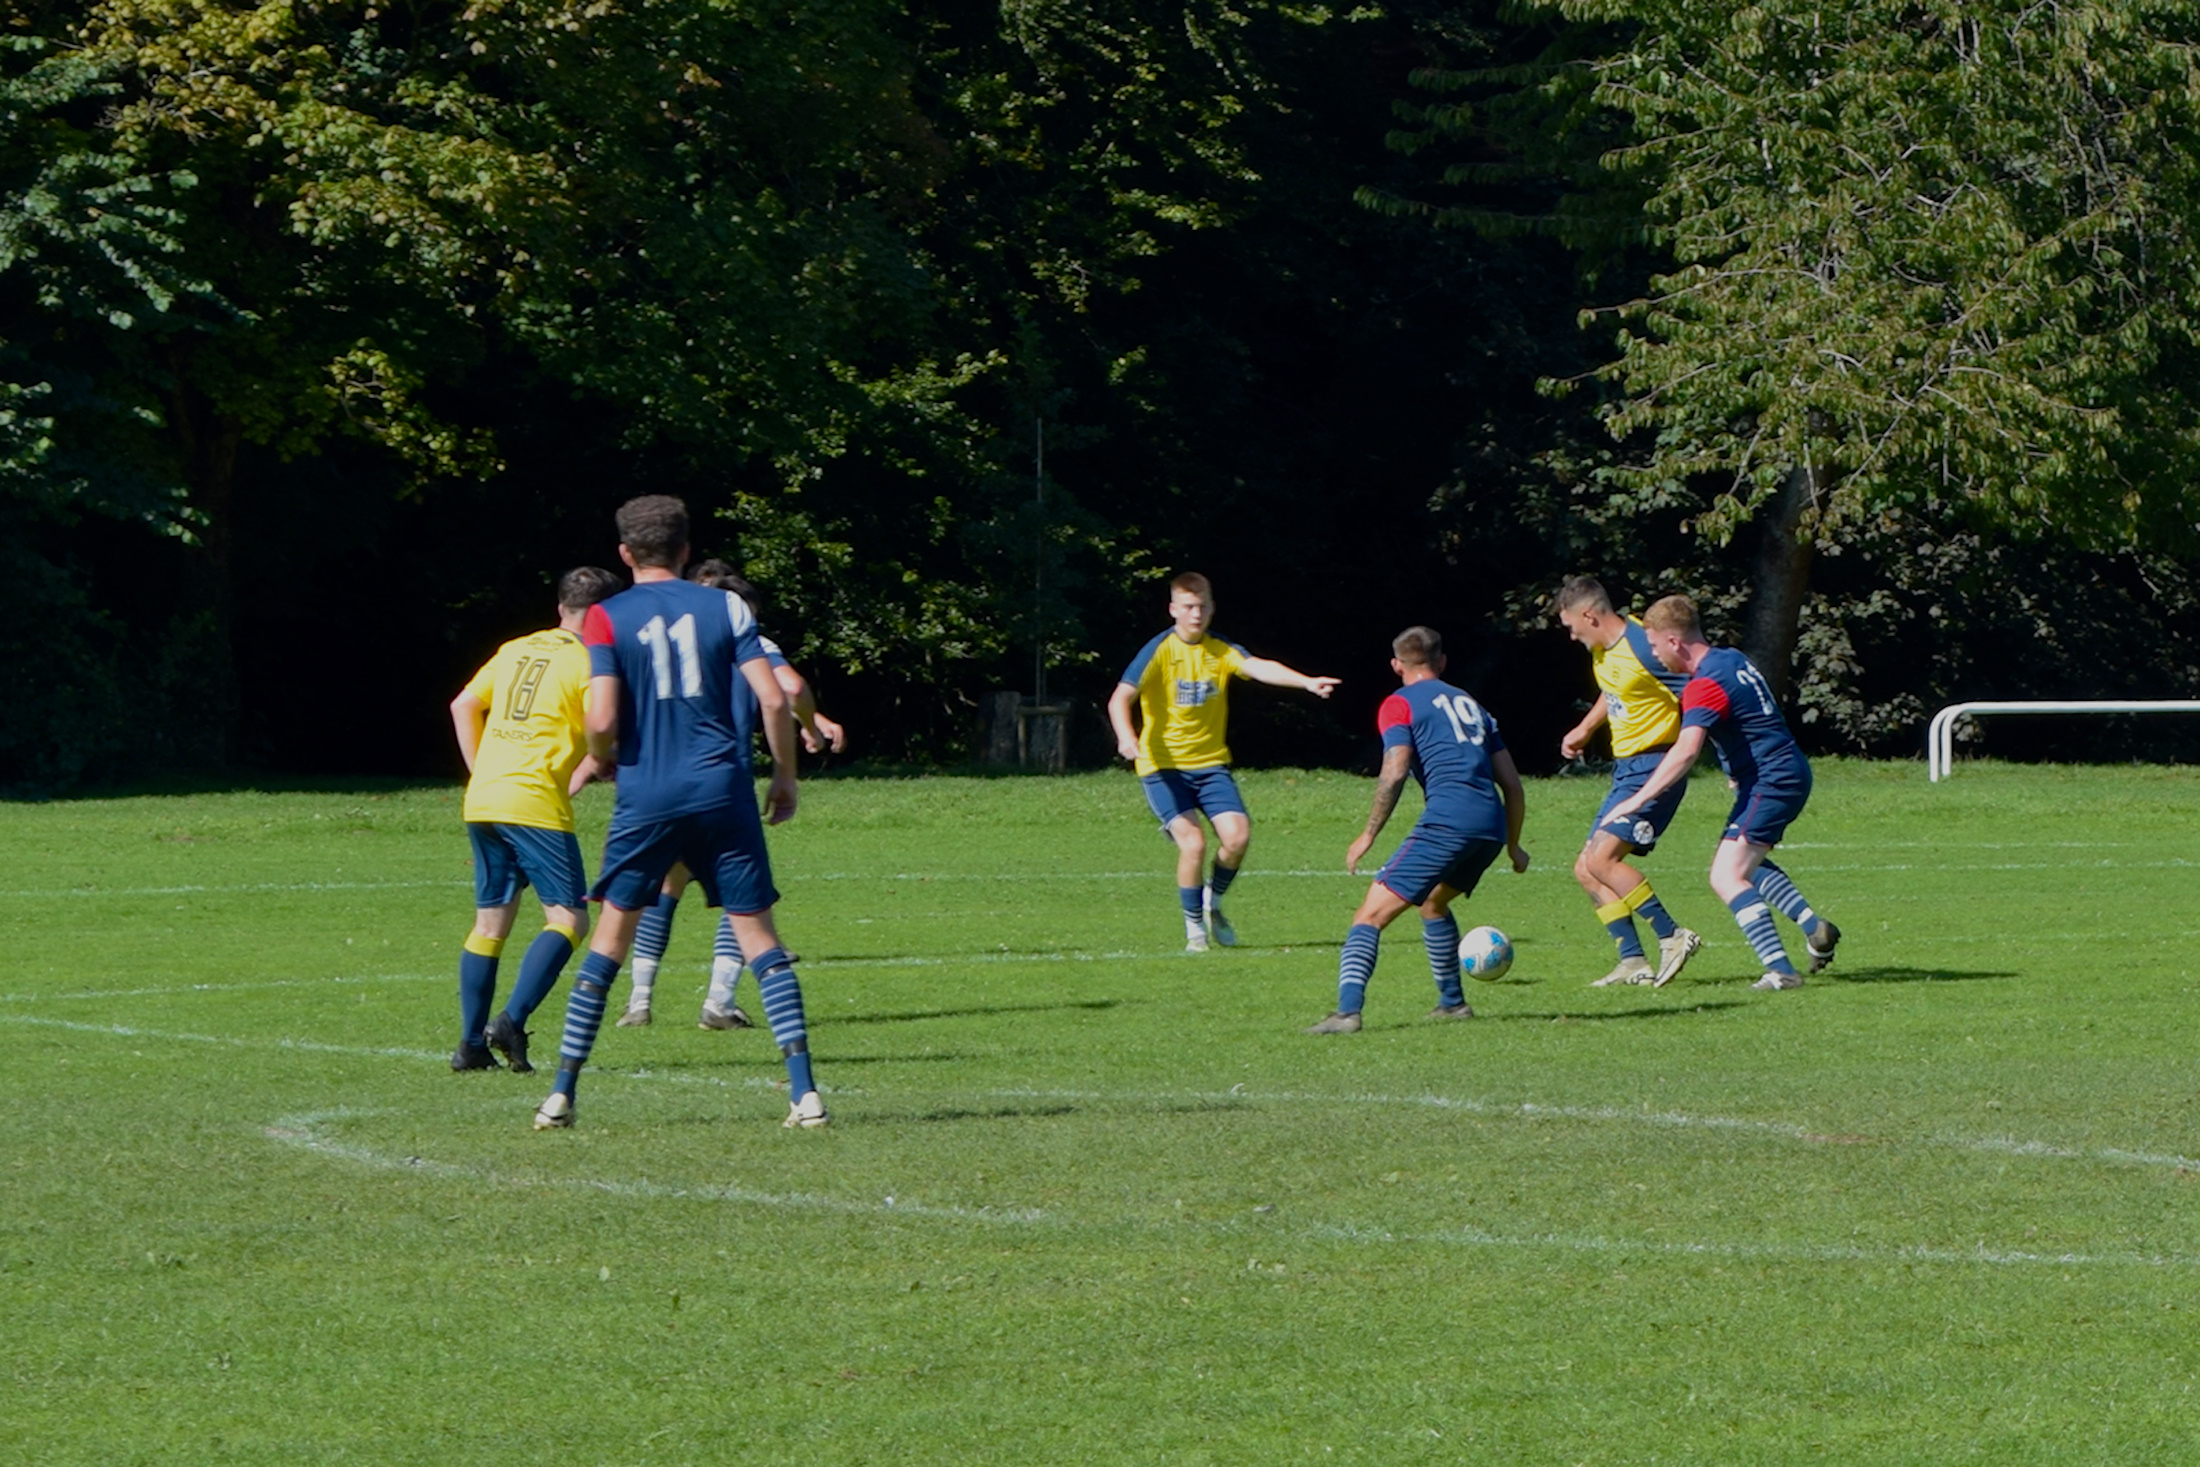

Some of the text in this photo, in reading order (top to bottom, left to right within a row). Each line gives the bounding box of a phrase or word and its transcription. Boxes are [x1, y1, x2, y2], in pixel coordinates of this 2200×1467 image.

[504, 656, 551, 721] 18
[636, 613, 703, 700] 11
[1432, 693, 1486, 746] 19
